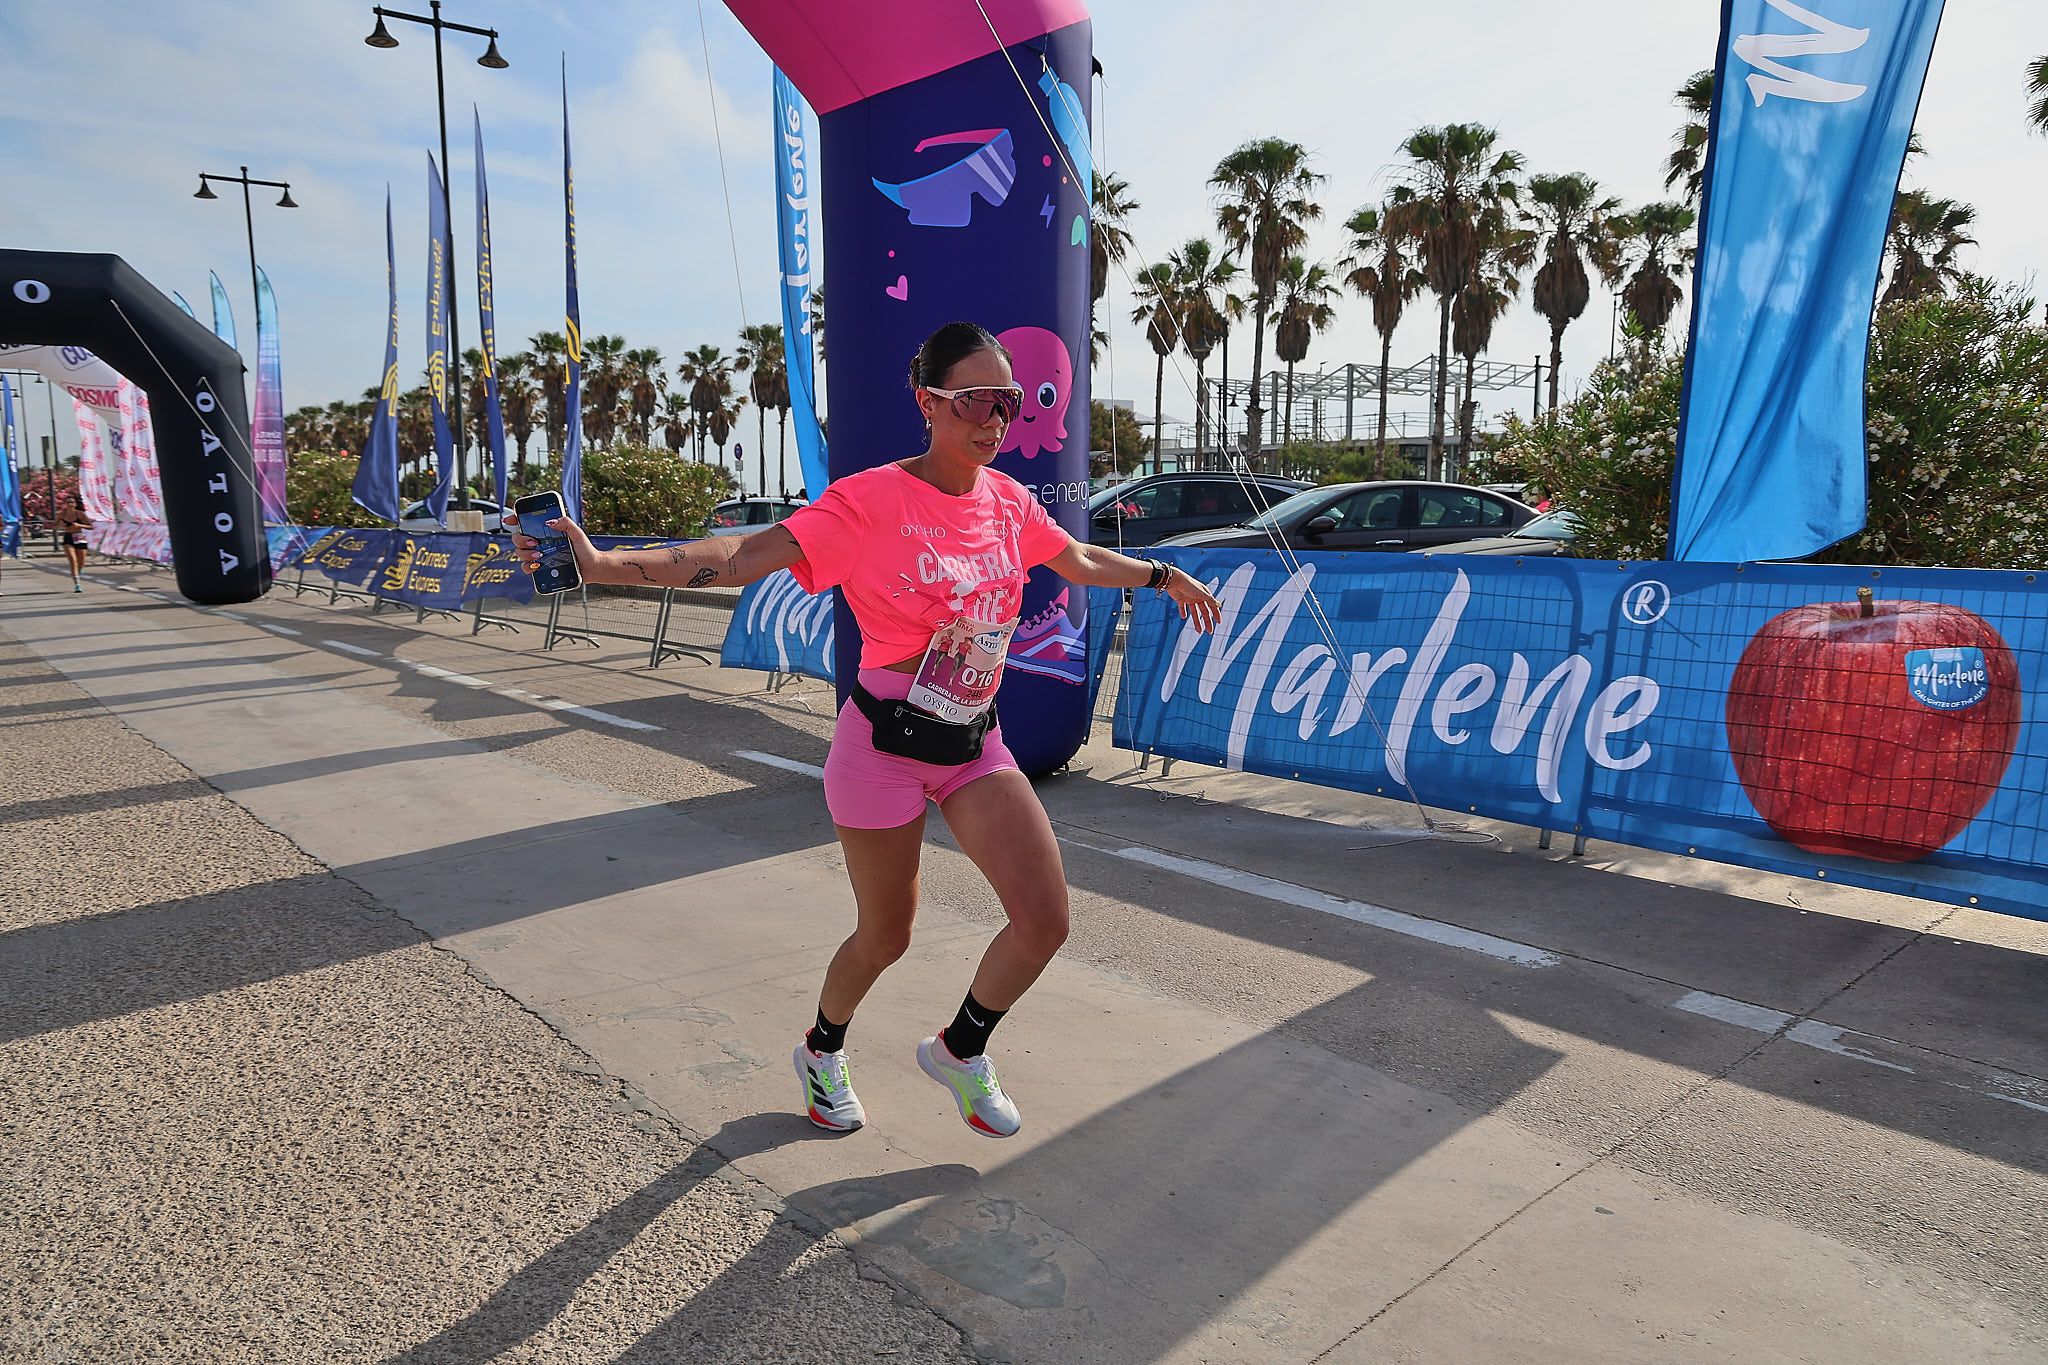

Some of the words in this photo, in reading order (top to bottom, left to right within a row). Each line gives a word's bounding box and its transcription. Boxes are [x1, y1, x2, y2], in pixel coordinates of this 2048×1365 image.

[195, 391, 240, 576] VOLVO
[927, 682, 952, 699] CARRERA
[1161, 561, 1661, 803] Marlene
[1913, 662, 1985, 696] Marlene
[923, 694, 958, 716] OYSHO
[1914, 689, 1951, 708] DAUGHTER
[1960, 698, 1974, 706] THE
